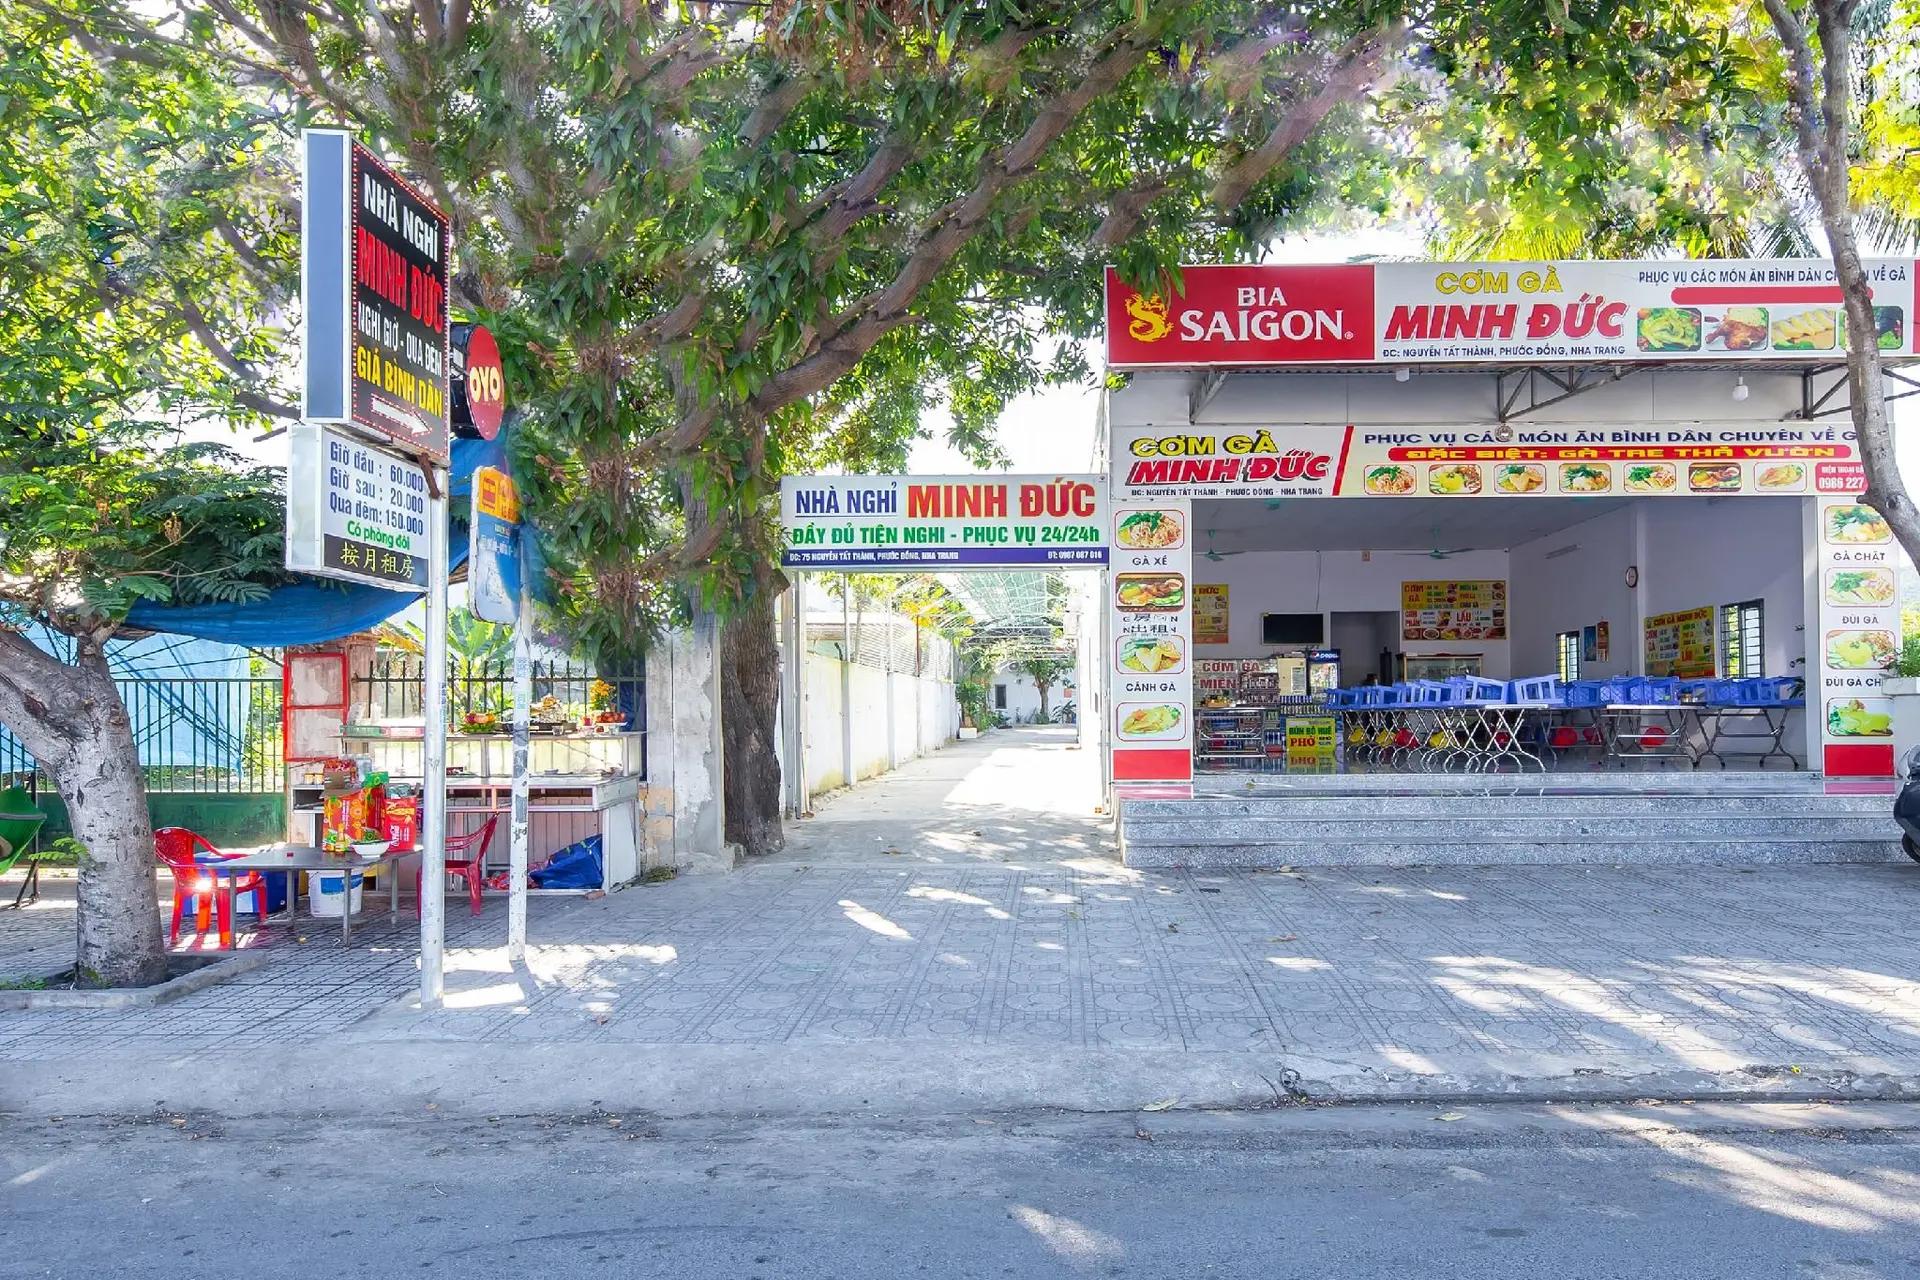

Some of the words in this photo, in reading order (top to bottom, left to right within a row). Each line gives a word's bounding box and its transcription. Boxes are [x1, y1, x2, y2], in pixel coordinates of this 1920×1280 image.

[364, 172, 399, 232] NHÀ
[403, 204, 438, 262] NGHỈ
[358, 225, 407, 311] MINH
[411, 264, 443, 334] ĐỨC
[1435, 268, 1508, 294] CƠM
[1517, 264, 1563, 294] GÀ
[1638, 270, 1669, 287] PHỤC
[1672, 270, 1688, 286] VỤ
[1690, 267, 1716, 283] CÁC
[1719, 267, 1746, 283] MÓN
[1749, 268, 1766, 283] ĂN
[1768, 266, 1795, 282] BÌNH
[1798, 266, 1823, 282] DÂN
[1873, 264, 1886, 281] VỀ
[1889, 266, 1906, 281] GÀ
[1238, 287, 1287, 306] BIA
[1180, 310, 1344, 342] SAIGON
[1383, 303, 1519, 341] MINH
[1527, 292, 1631, 340] ĐỨC
[358, 301, 382, 342] NGHỈ
[383, 316, 399, 352] GIỜ
[406, 331, 423, 367] QUA
[424, 340, 442, 378] ĐÊM
[1383, 349, 1401, 357] ĐC:
[1402, 344, 1441, 357] NGUYỄN
[1443, 345, 1460, 357] TẤT
[1462, 345, 1497, 357] THÀNH,
[1500, 344, 1534, 356] PHƯỚC
[1536, 343, 1568, 357] ĐỒNG,
[1571, 346, 1591, 355] NHA
[1594, 346, 1626, 355] TRANG
[357, 345, 381, 387] GIÁ
[384, 357, 416, 404] BÌNH
[418, 379, 443, 418] DÂN
[470, 366, 501, 403] OYO
[1130, 434, 1215, 457] CƠM
[1222, 429, 1279, 456] GÀ
[1364, 433, 1423, 446] PHỤC
[1429, 433, 1457, 446] VỤ
[1518, 428, 1571, 443] MÓN
[1575, 428, 1604, 443] ĂN
[1611, 427, 1660, 443] BÌNH
[1667, 428, 1712, 442] DÂN
[1719, 427, 1803, 442] CHUYÊN
[1811, 425, 1836, 441] VỀ
[330, 441, 350, 466] Giờ
[354, 450, 374, 475] đầu
[390, 464, 424, 493] 60.000
[1125, 457, 1243, 486] MINH
[1242, 448, 1334, 481] ĐỨC
[1406, 448, 1466, 461] ĐẶC
[1476, 447, 1548, 460] BIỆT:
[1558, 447, 1599, 458] GÀ
[1744, 446, 1835, 457] VƯỜN
[330, 467, 350, 490] Giờ
[355, 479, 376, 499] sau
[390, 487, 424, 514] 20.000
[795, 484, 840, 514] NHÀ
[846, 481, 897, 514] NGHỈ
[907, 485, 1007, 518] MINH
[1019, 476, 1096, 518] ĐỨC
[1280, 488, 1297, 496] NHA
[1298, 487, 1323, 495] TRANG
[1819, 477, 1844, 489] 0986
[1845, 477, 1865, 489] 227
[330, 491, 352, 515] Qua
[385, 509, 424, 536] 150.000
[347, 520, 362, 537] Có
[363, 526, 394, 549] phòng
[791, 521, 826, 545] ĐẦY
[831, 521, 855, 544] ĐỦ
[859, 523, 898, 548] TIỆN
[903, 526, 945, 544] NGHI
[963, 526, 1008, 547] PHỤC
[1014, 526, 1036, 547] VỤ
[1041, 525, 1099, 543] 24/24h
[340, 541, 415, 580] 按月租房
[1132, 554, 1150, 566] GÀ
[1154, 555, 1168, 566] XÉ
[1833, 550, 1851, 561] GÀ
[1854, 551, 1886, 563] CHẶT
[1842, 615, 1860, 624] ĐÙI
[1863, 615, 1879, 624] GÀ
[1202, 661, 1234, 672] CƠM
[1125, 681, 1156, 692] CÁNH
[1159, 681, 1176, 692] GÀ
[1826, 677, 1844, 687] ĐÙI
[1846, 677, 1862, 687] GÀ
